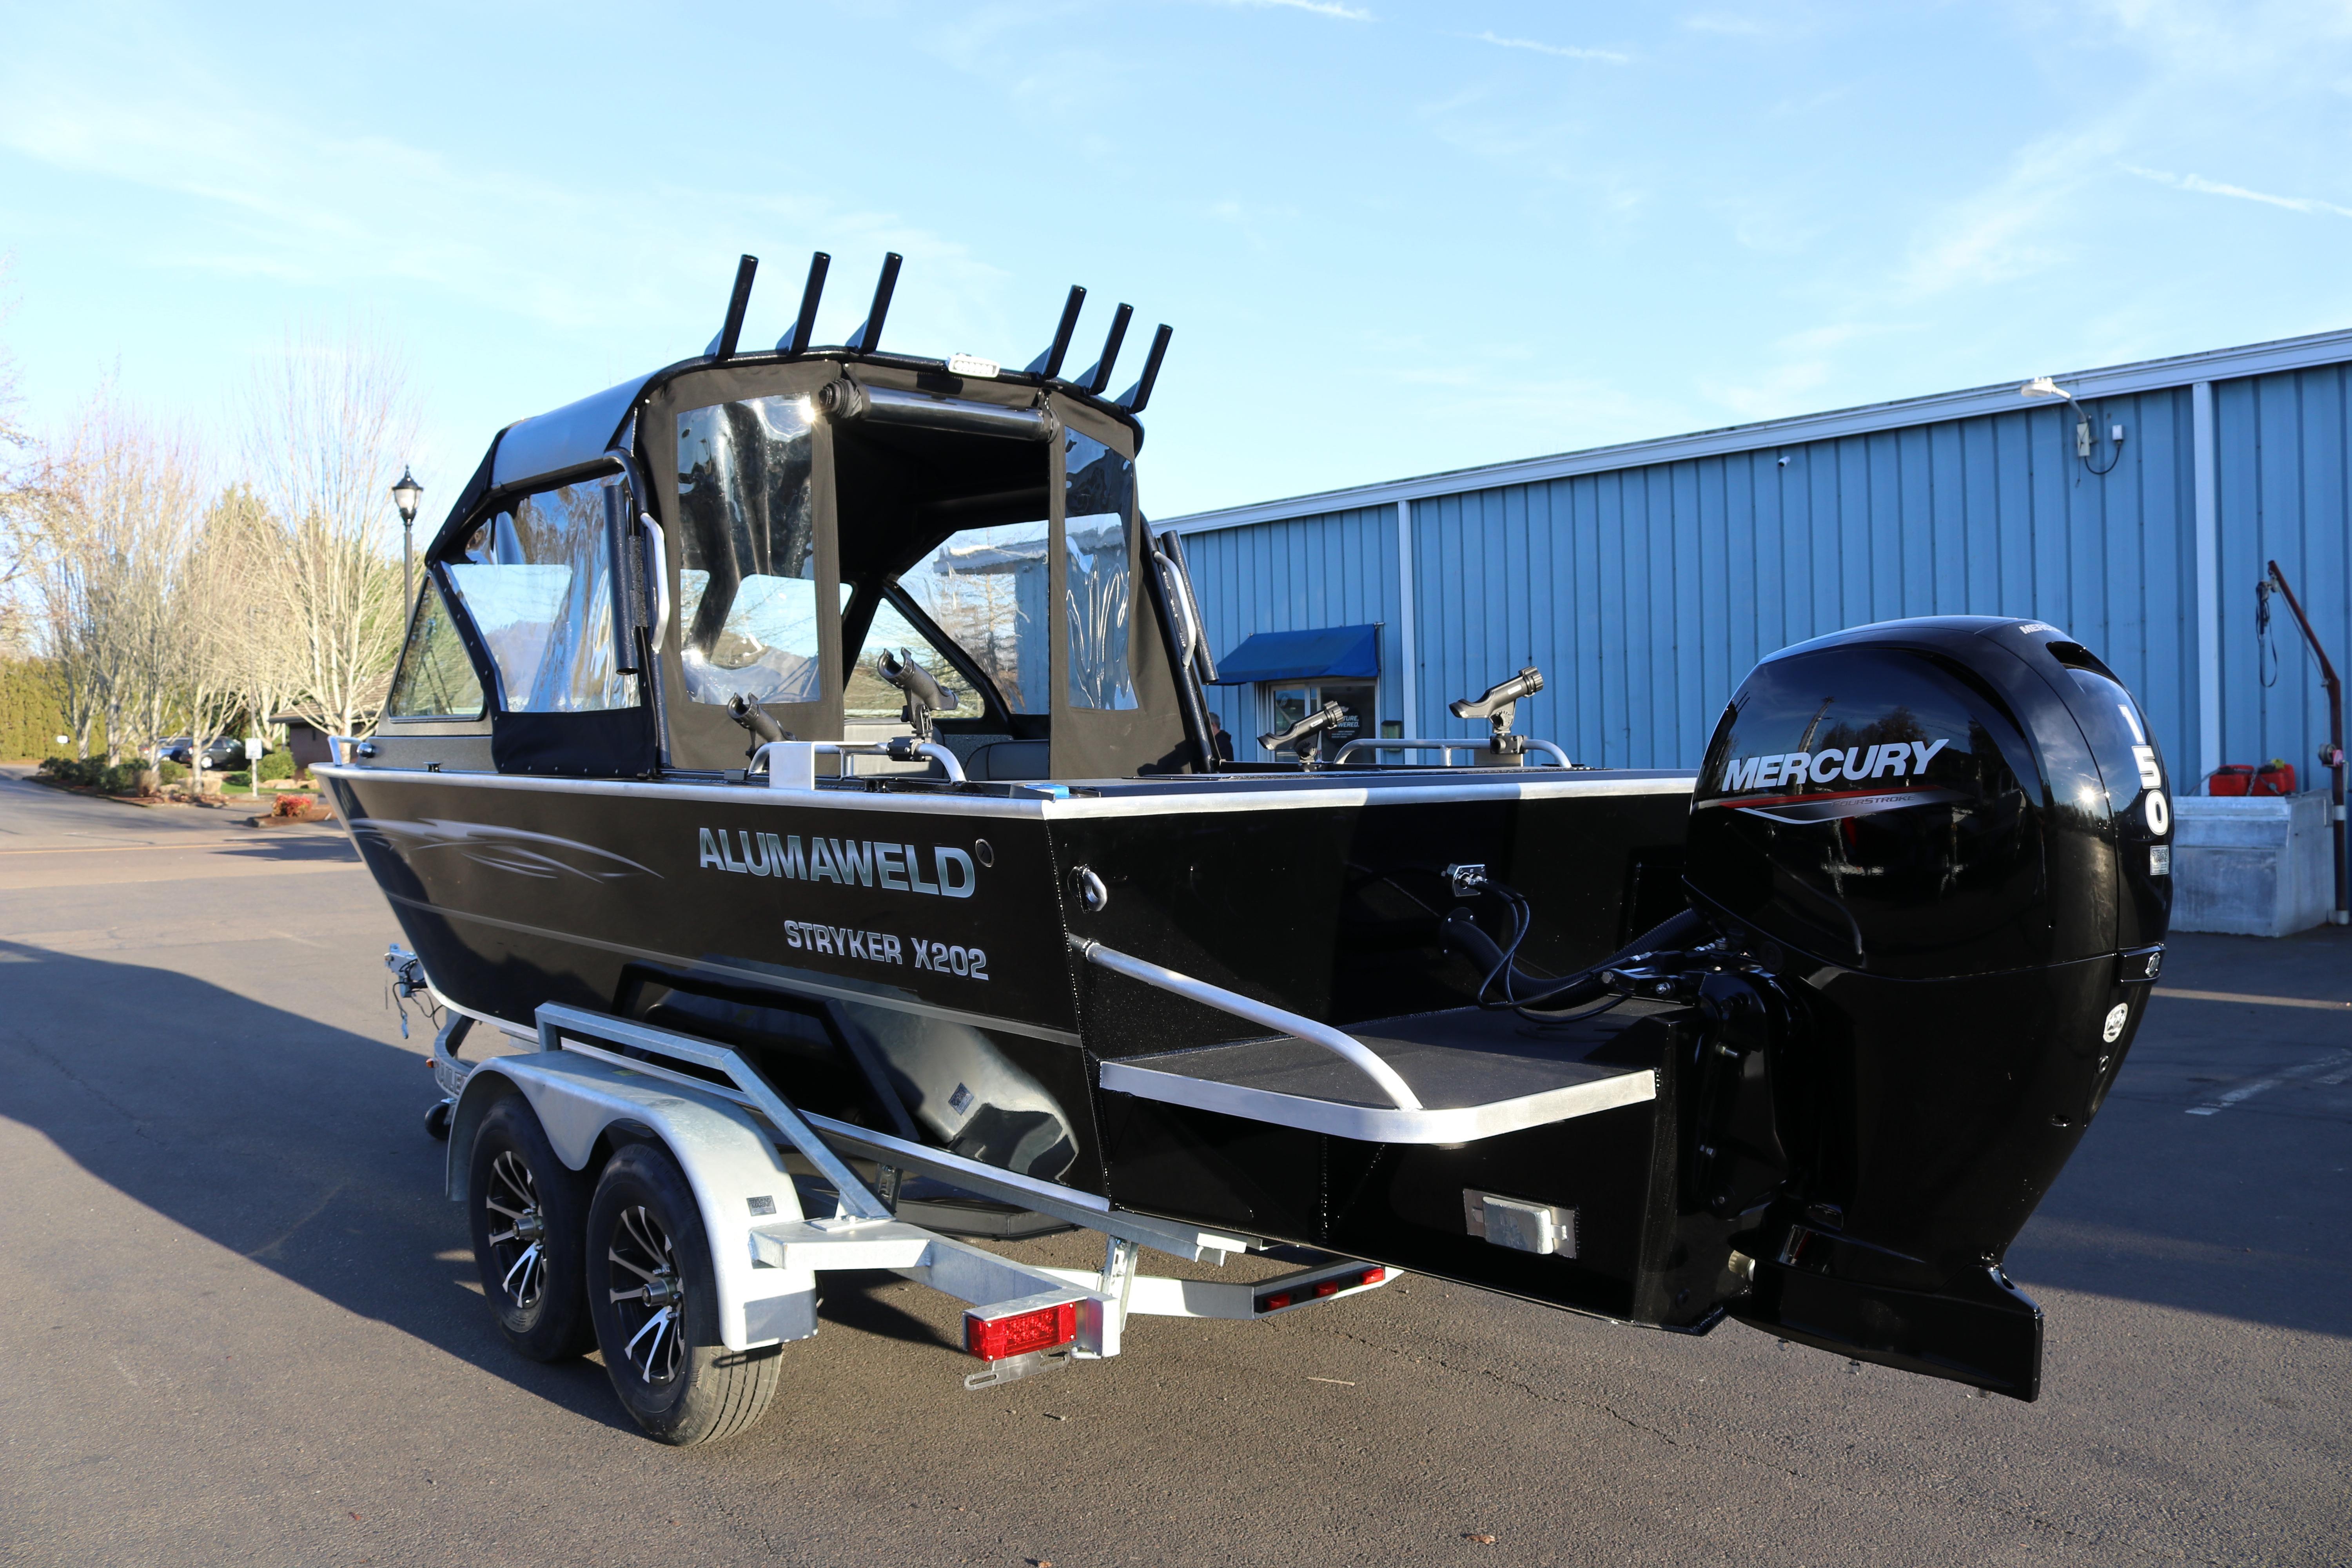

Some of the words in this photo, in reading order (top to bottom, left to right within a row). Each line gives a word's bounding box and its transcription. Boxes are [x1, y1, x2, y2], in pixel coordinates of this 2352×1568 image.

[1722, 739, 1949, 791] MERCURY
[2118, 704, 2169, 836] 150
[1832, 795, 1915, 806] FOURSTROKE
[699, 827, 975, 898] ALUMAWELD
[784, 920, 902, 965] STRYKER
[911, 937, 989, 980] X202
